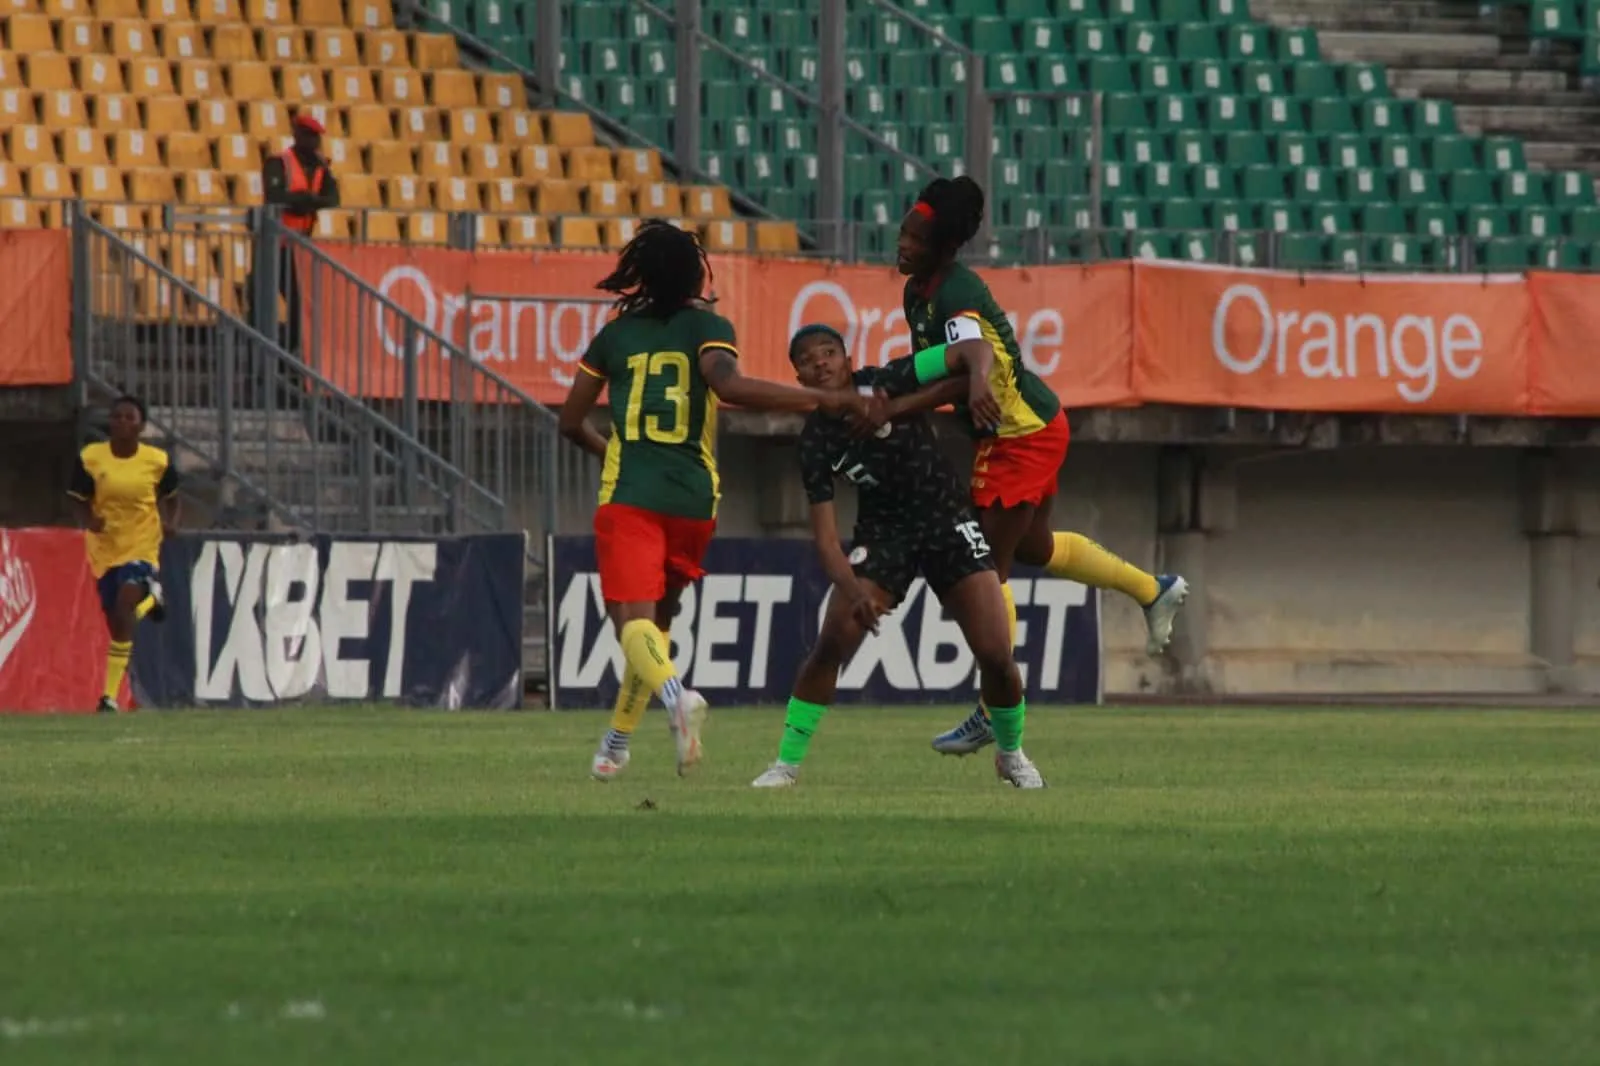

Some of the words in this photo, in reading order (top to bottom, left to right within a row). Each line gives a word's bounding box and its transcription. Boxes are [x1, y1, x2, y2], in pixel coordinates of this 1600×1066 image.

[376, 265, 612, 387] Orang
[789, 280, 1063, 376] Orae
[948, 320, 960, 341] C
[1212, 284, 1482, 402] Orange
[625, 351, 690, 443] 13
[955, 520, 991, 550] 15
[191, 541, 437, 700] 1XBET
